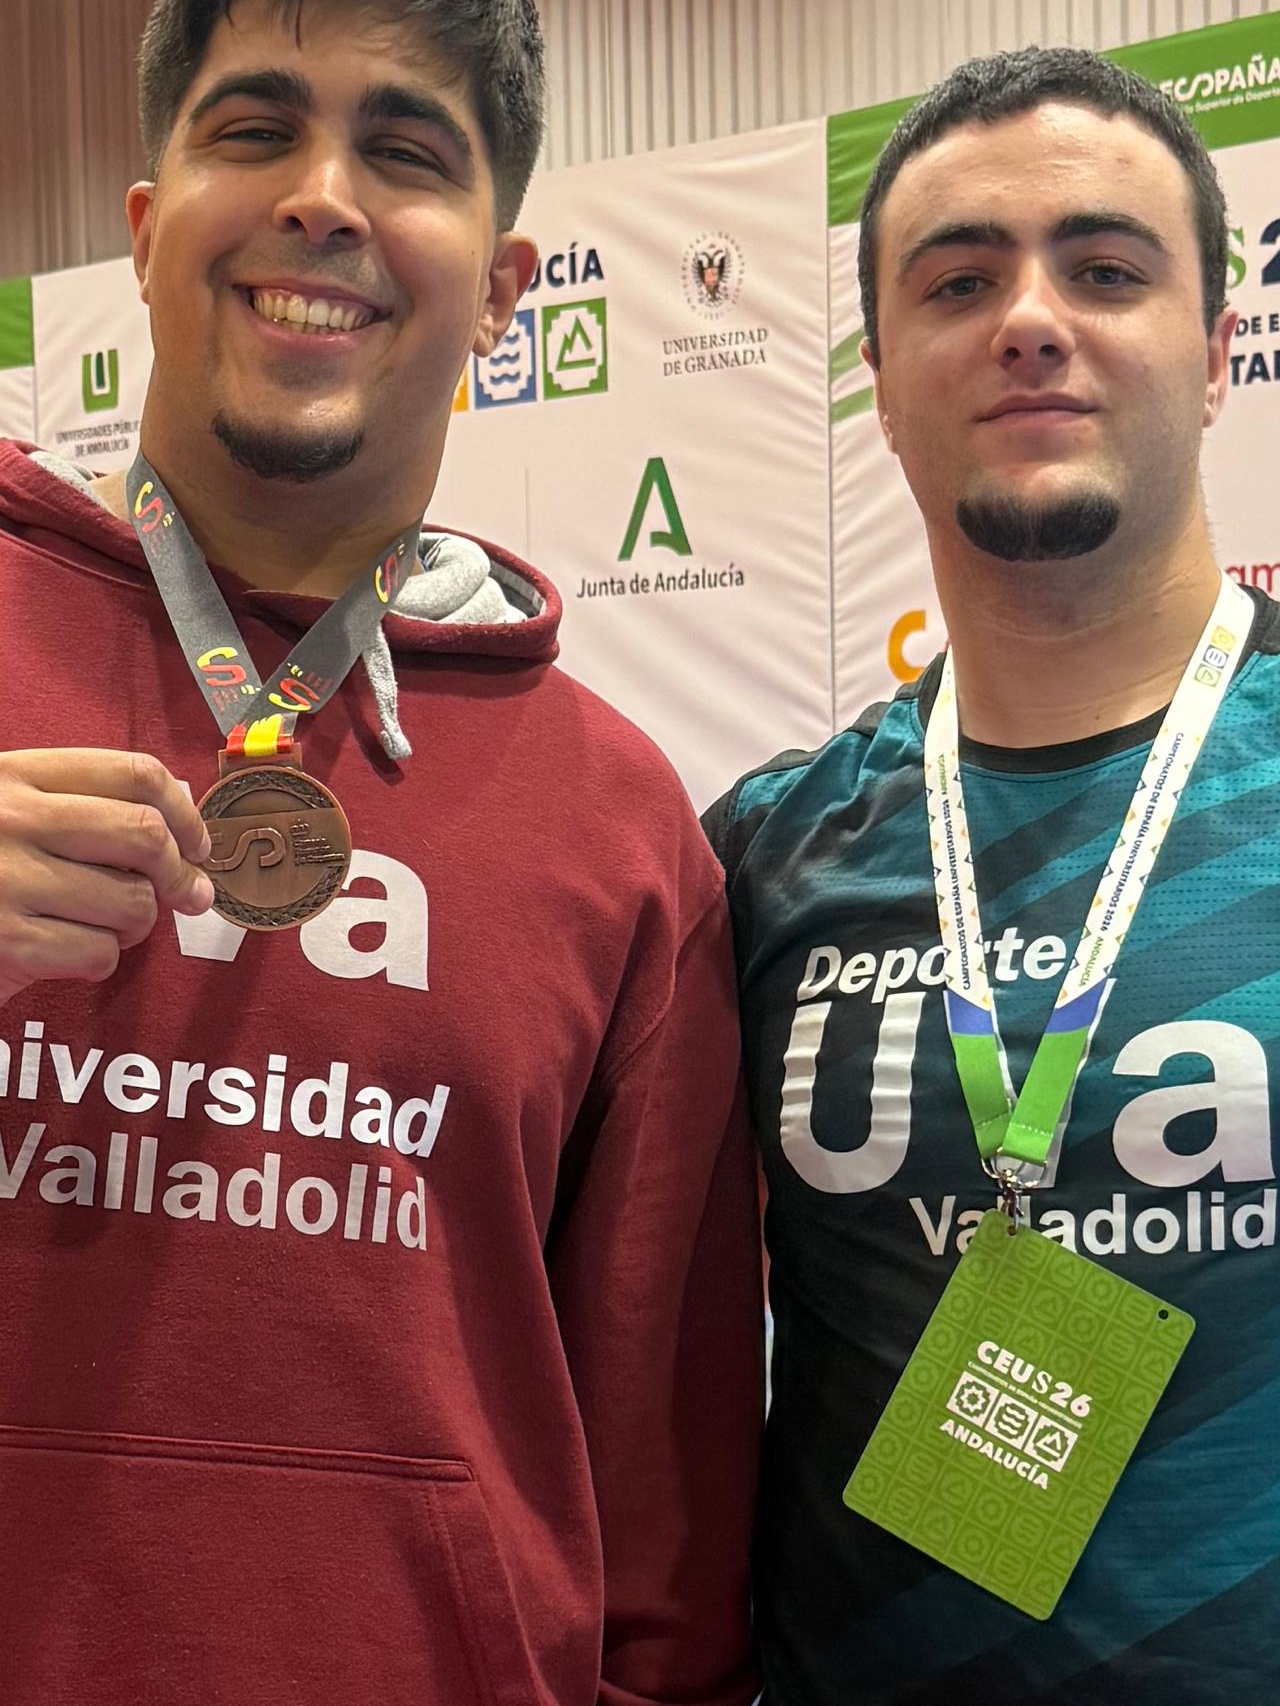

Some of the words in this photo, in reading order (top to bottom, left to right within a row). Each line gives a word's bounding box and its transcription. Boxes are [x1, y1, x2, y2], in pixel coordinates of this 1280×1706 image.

[662, 328, 768, 355] UNIVERSIDAD
[1234, 316, 1262, 337] DE
[663, 360, 683, 377] DE
[684, 348, 767, 374] GRANADA
[576, 576, 626, 599] Junta
[628, 572, 651, 594] de
[654, 562, 745, 593] Andalucía
[797, 927, 1066, 1003] Depote
[977, 1340, 1093, 1417] CEUS26
[939, 1418, 1049, 1490] ANDALUCÍA
